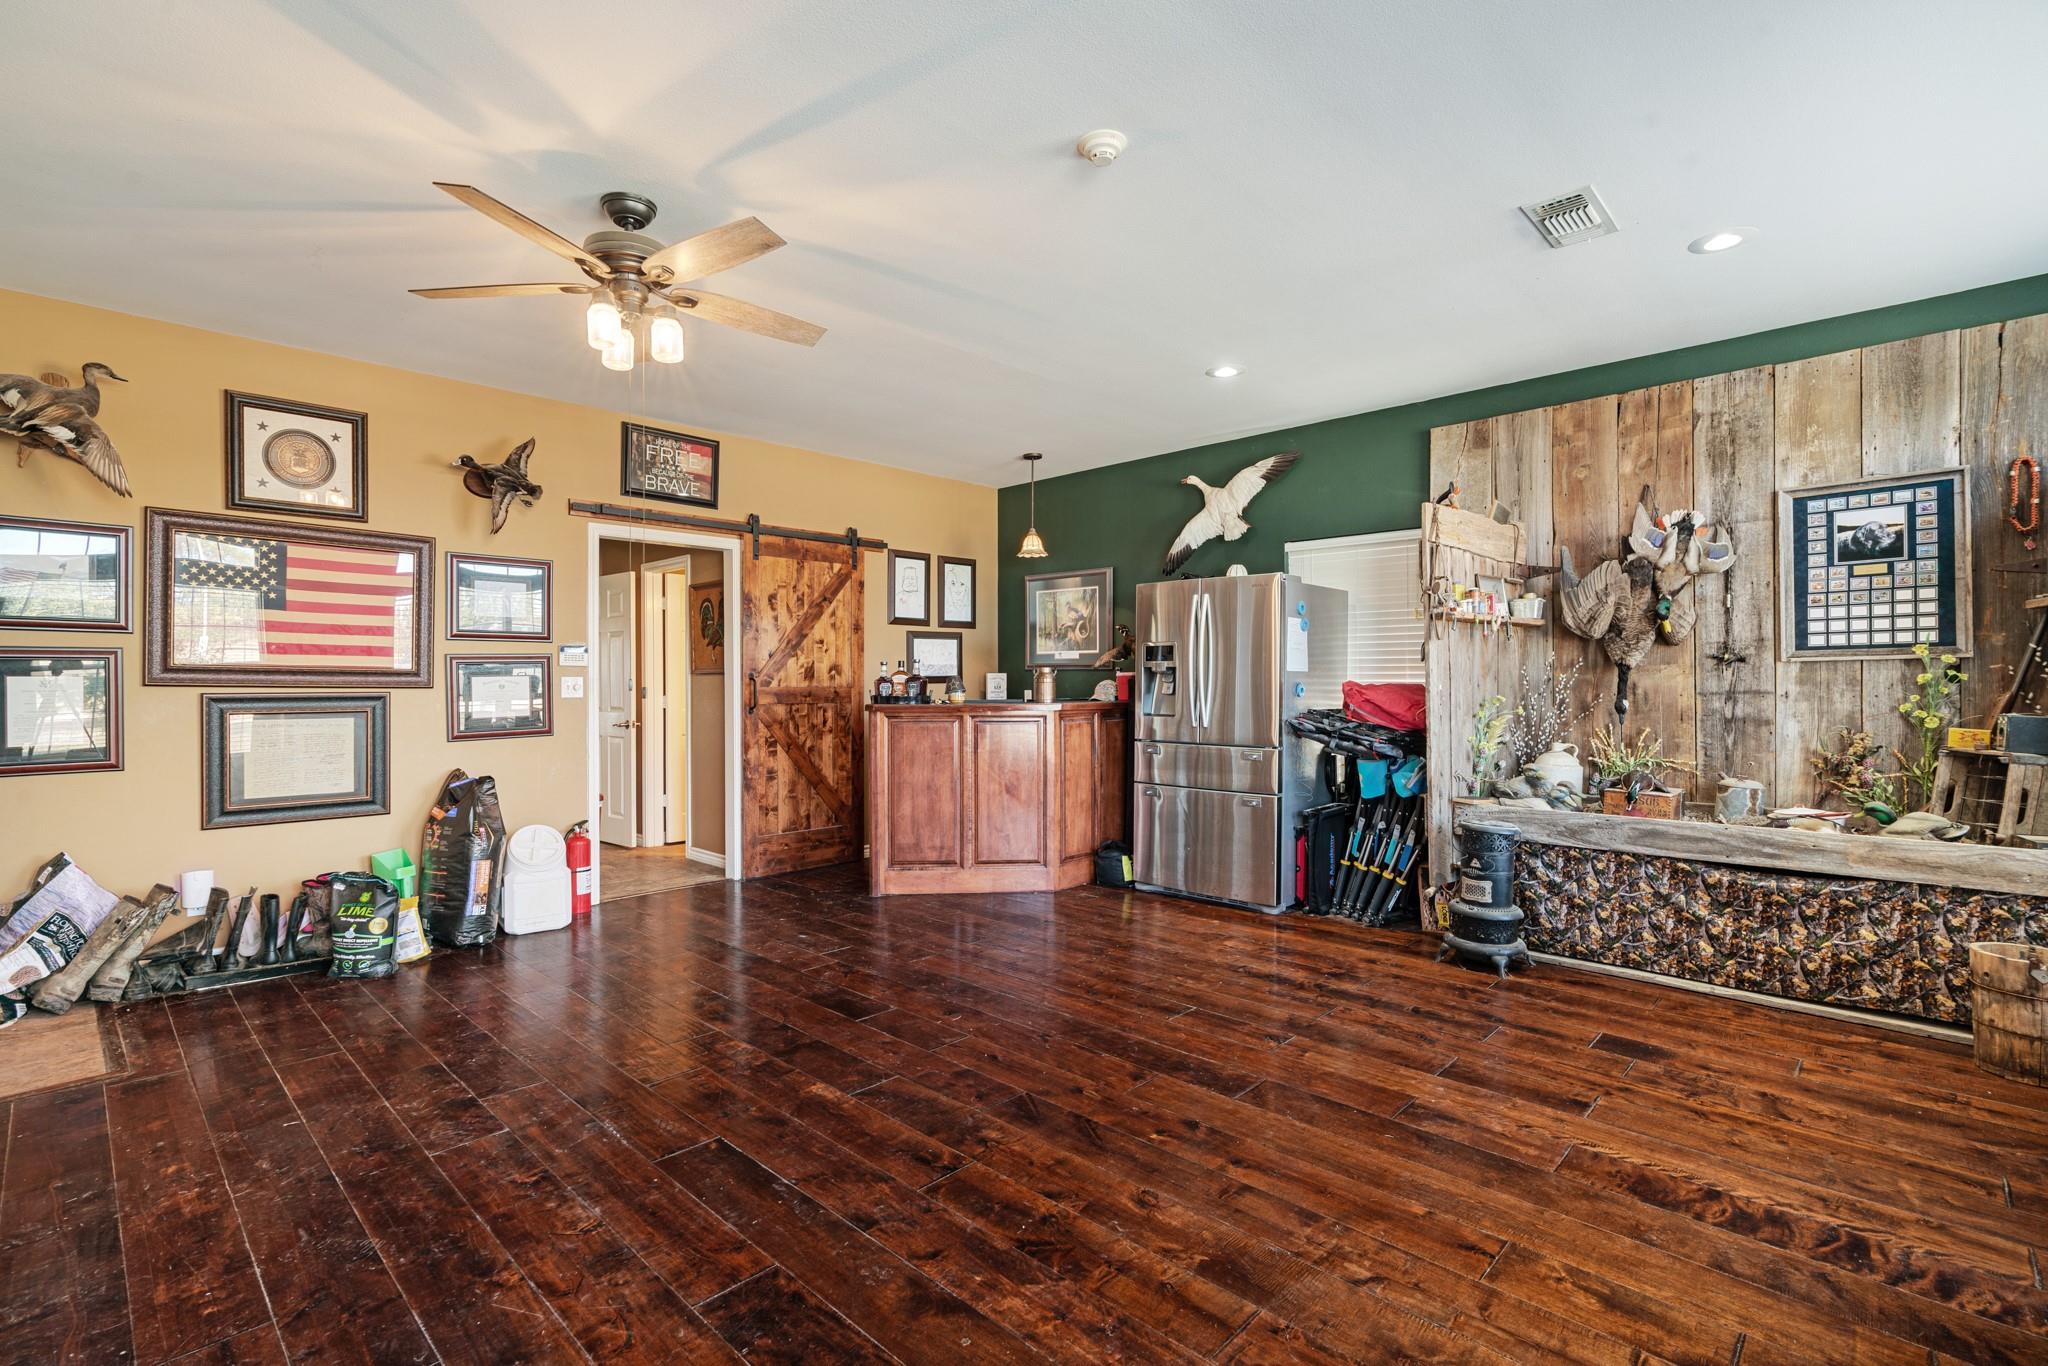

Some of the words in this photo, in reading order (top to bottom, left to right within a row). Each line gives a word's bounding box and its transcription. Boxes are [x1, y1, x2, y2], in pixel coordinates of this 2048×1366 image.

[655, 437, 672, 447] HOME
[672, 440, 681, 449] OF
[646, 444, 701, 468] FREE
[651, 467, 676, 478] BECAUSE
[645, 474, 701, 497] BRAVE
[337, 906, 375, 917] LIME
